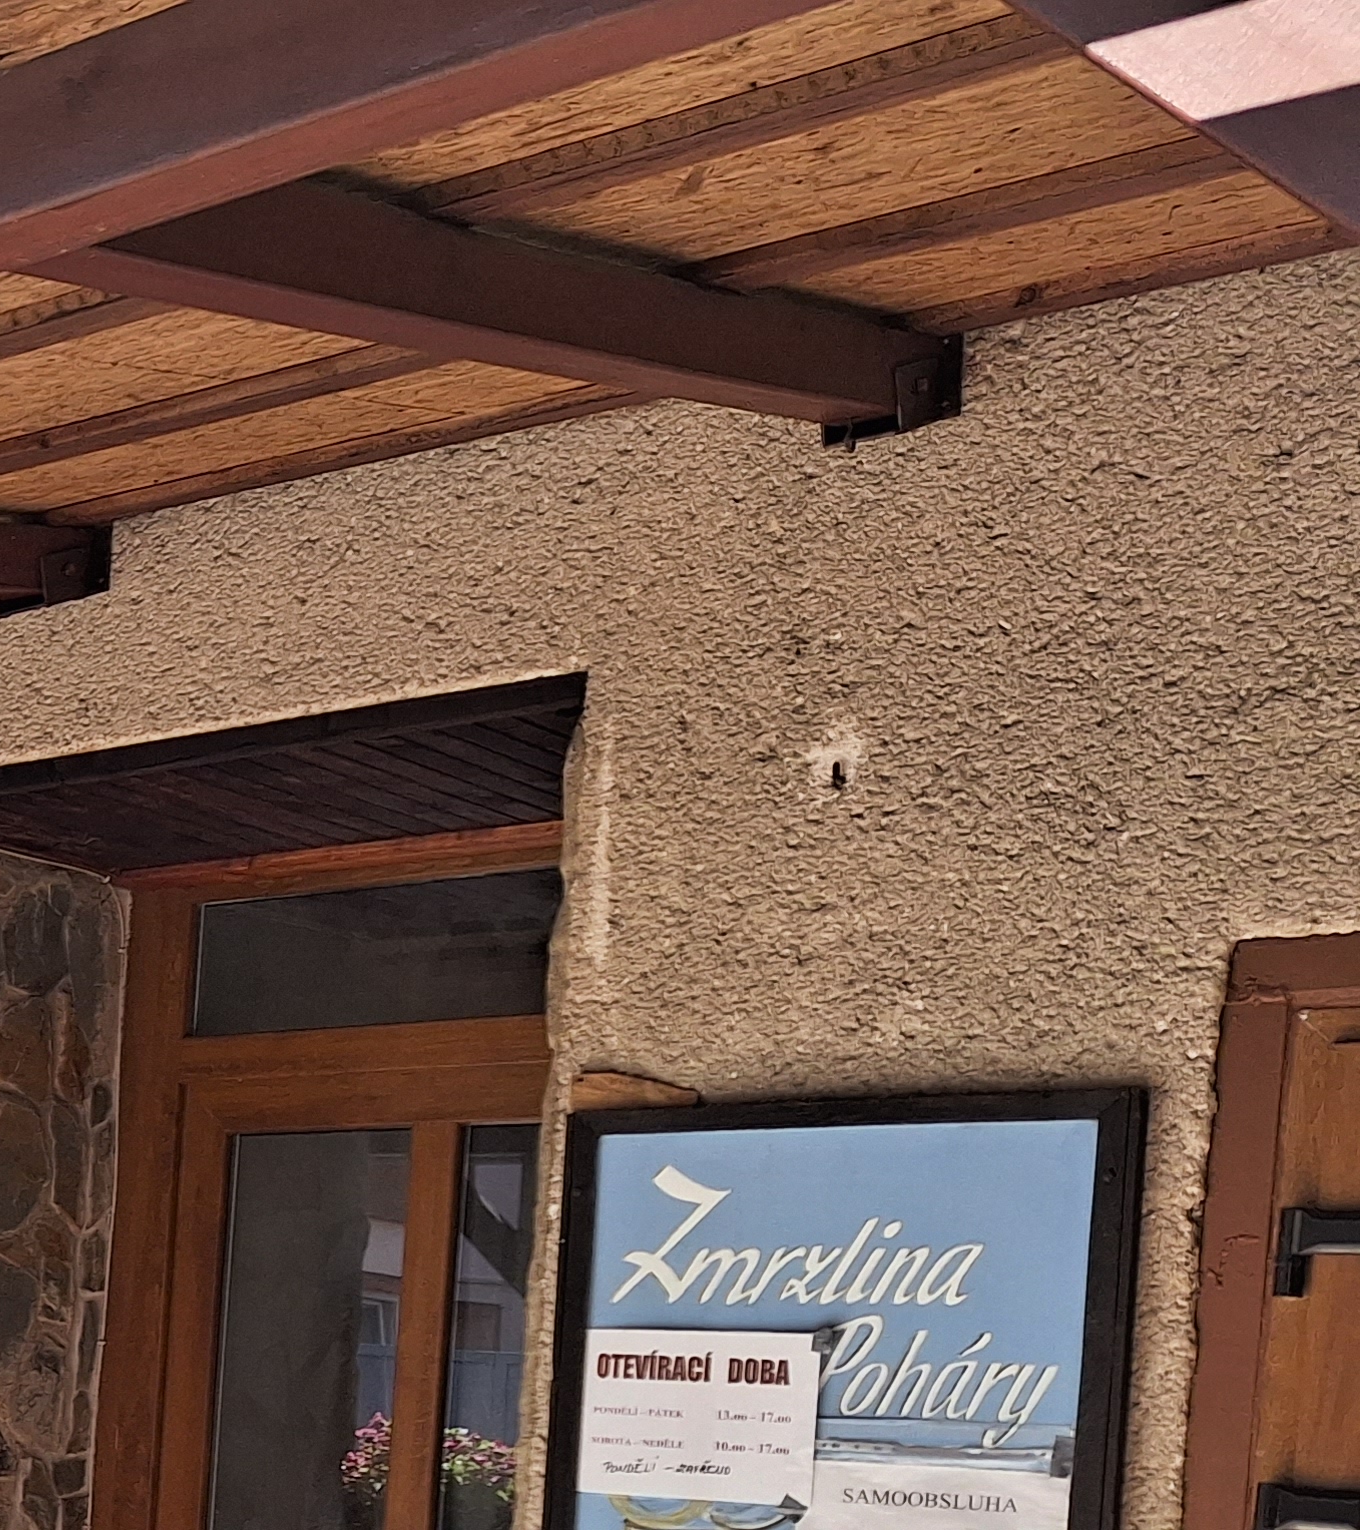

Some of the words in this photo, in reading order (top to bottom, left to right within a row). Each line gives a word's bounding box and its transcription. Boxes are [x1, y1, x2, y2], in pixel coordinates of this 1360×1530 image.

[610, 1164, 984, 1306] Zmrzlina
[596, 1349, 714, 1383] OTEVÍRACÍ
[727, 1358, 791, 1386] DOBA
[820, 1315, 1060, 1449] Poháry
[842, 1487, 1018, 1513] SAMOOBSLUHA
